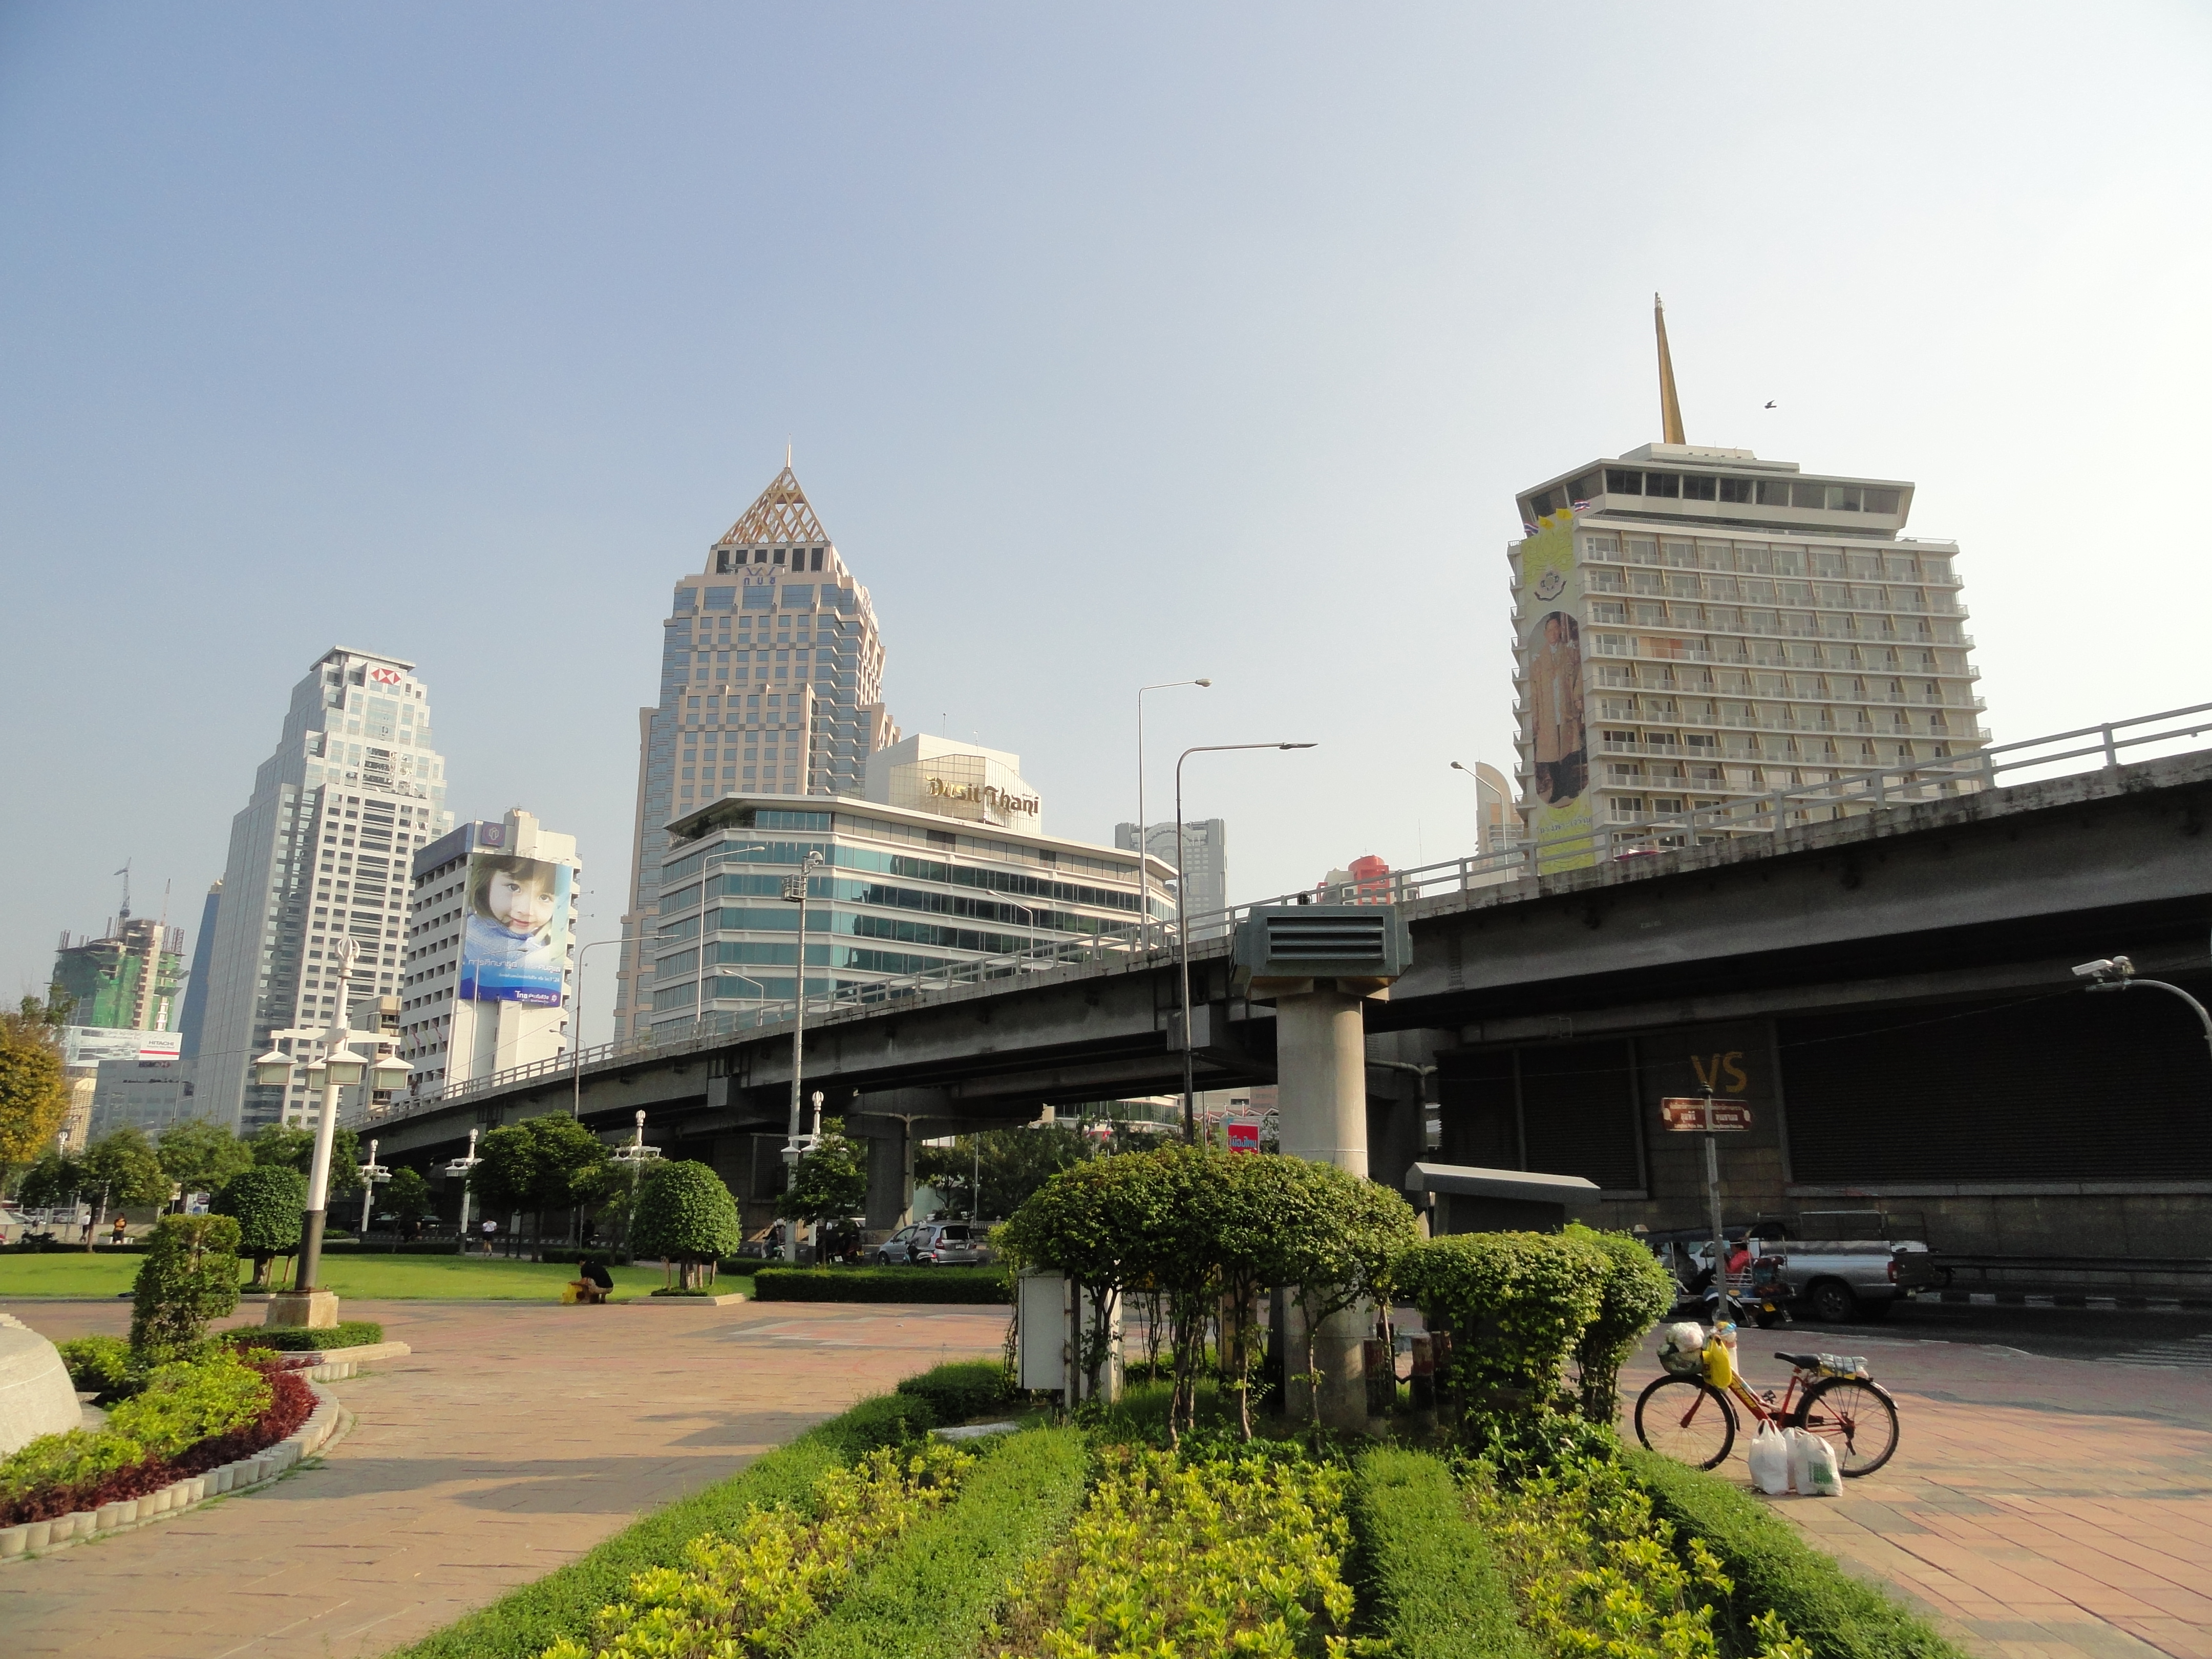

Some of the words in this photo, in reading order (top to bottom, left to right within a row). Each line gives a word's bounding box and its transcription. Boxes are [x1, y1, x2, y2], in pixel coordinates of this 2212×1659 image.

[925, 774, 983, 803] Dusit
[984, 785, 1039, 817] Thani
[1690, 1051, 1747, 1094] VS
